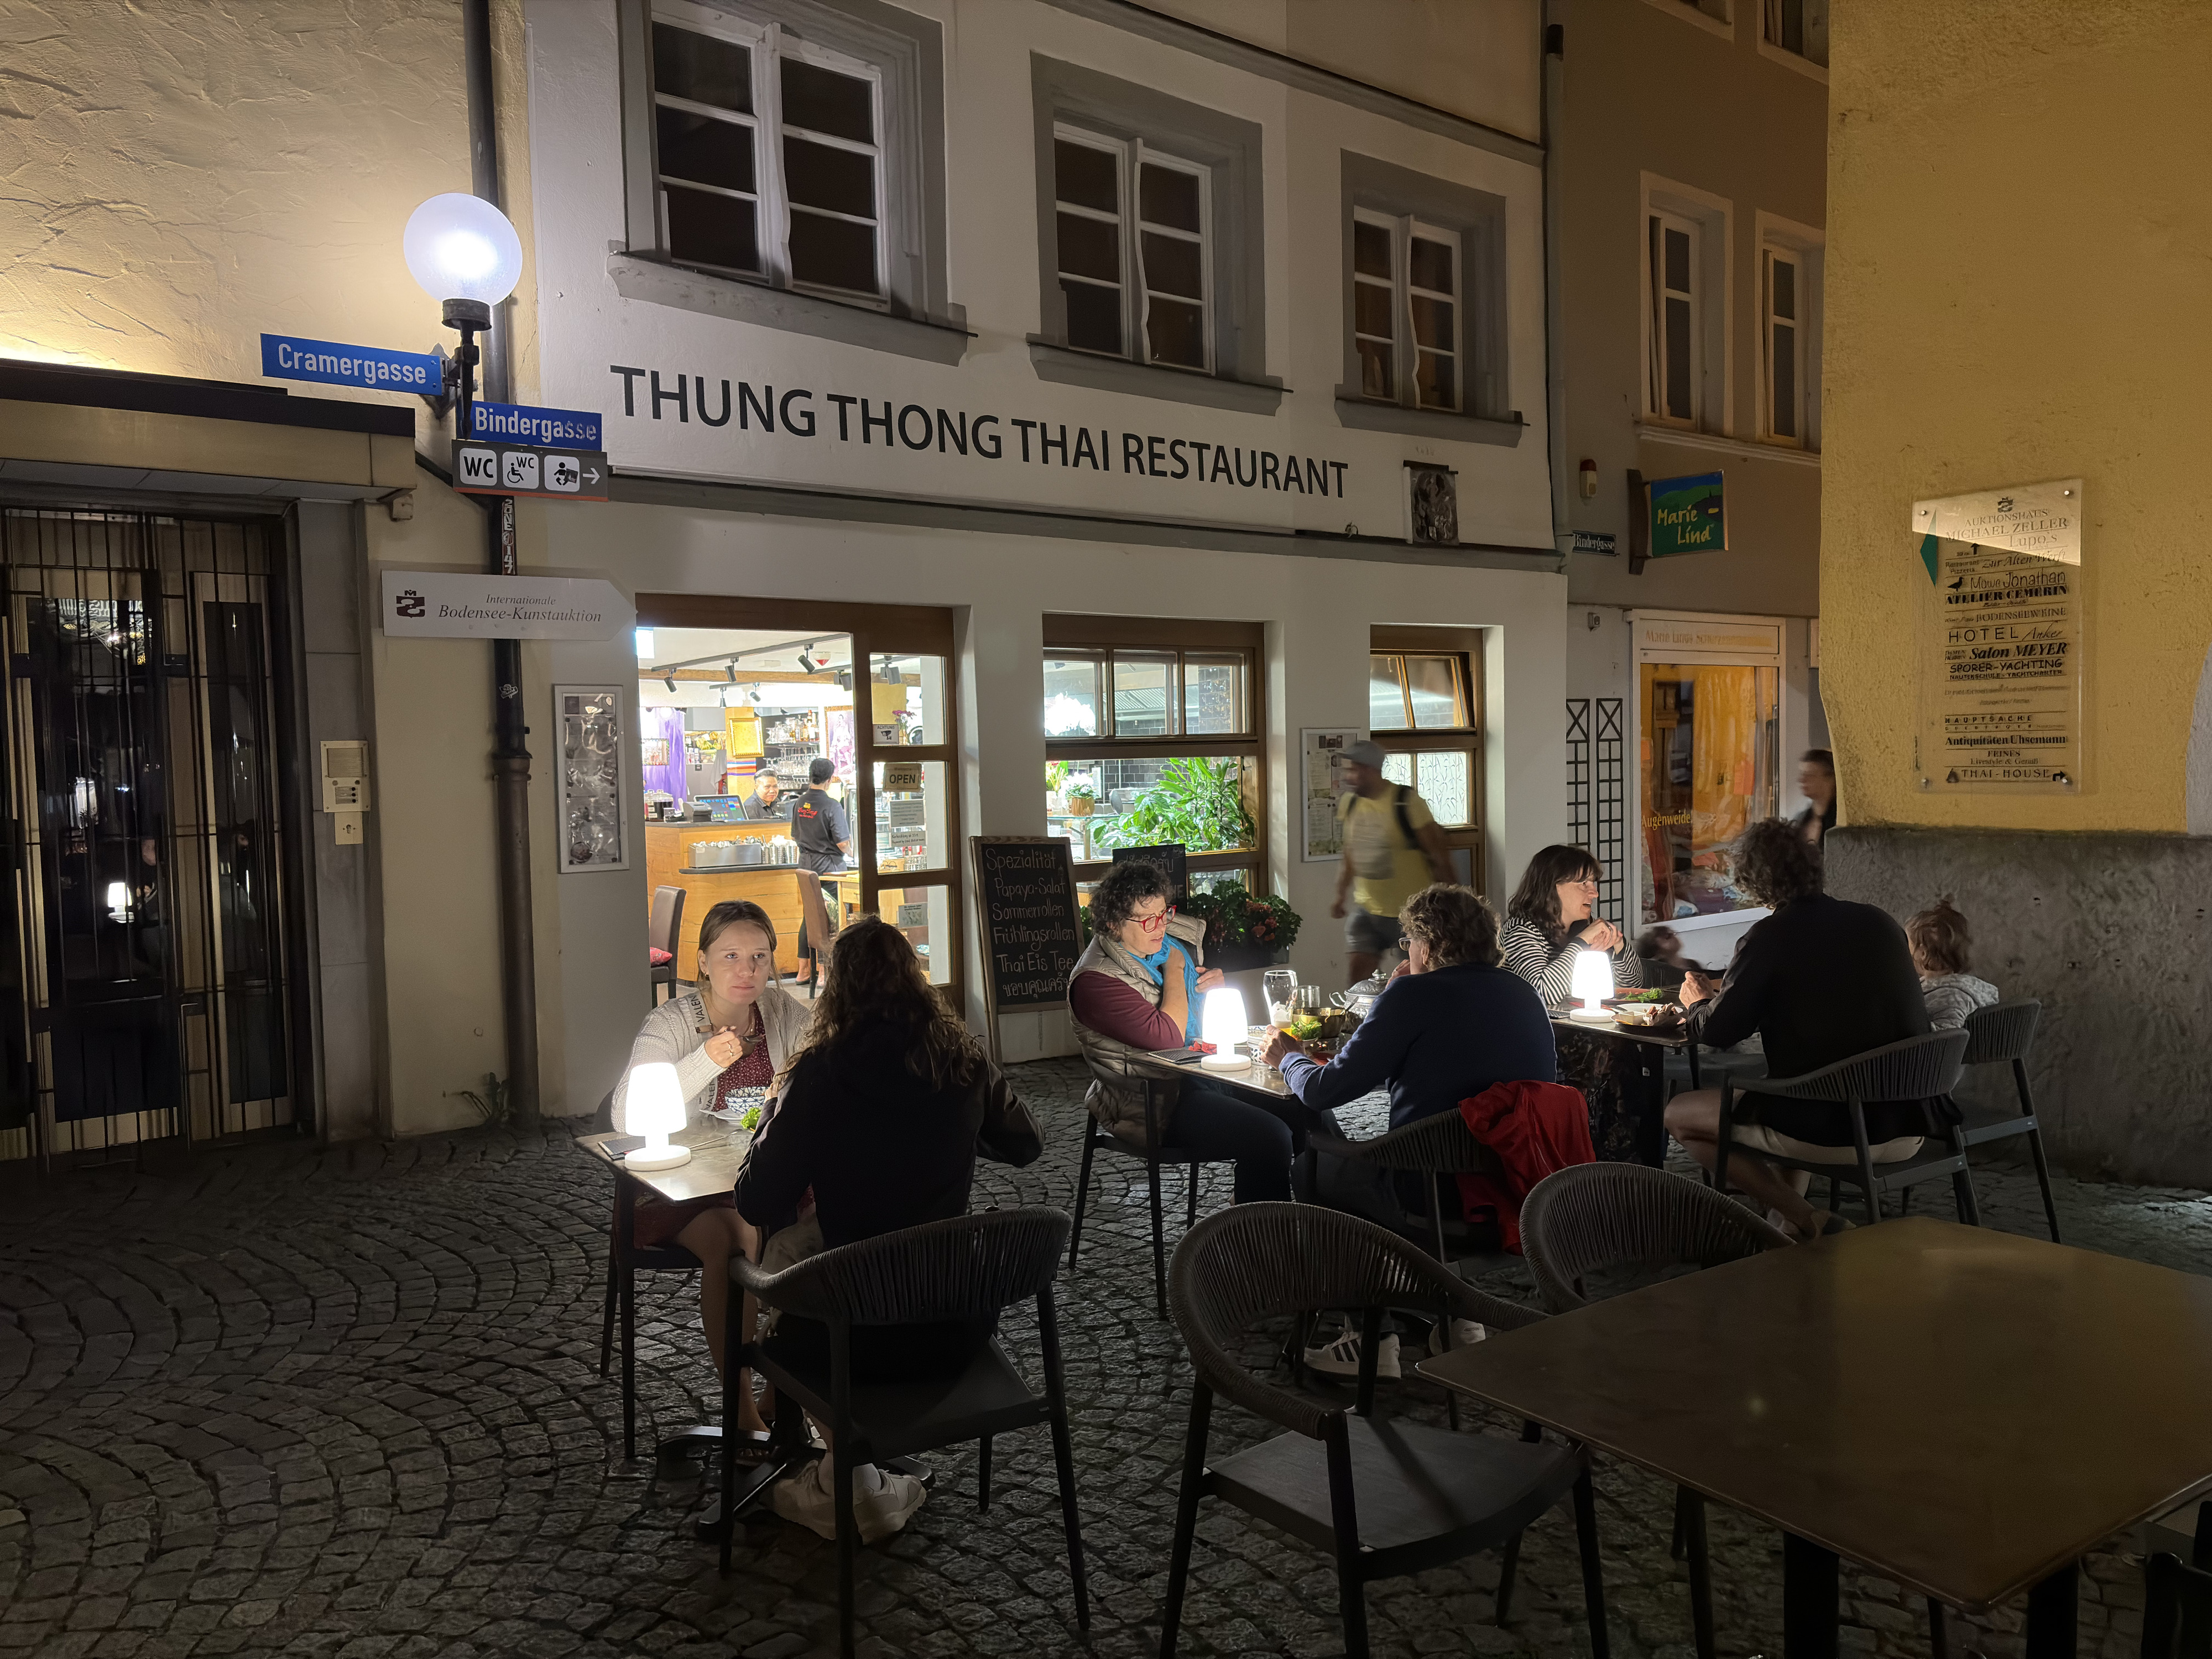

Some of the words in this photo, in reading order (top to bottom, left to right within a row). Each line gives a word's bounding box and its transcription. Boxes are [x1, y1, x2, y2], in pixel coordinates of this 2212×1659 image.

[278, 343, 426, 385] Cramergasse
[475, 406, 597, 443] Bindergasse
[610, 364, 816, 437] THUNG
[827, 393, 1002, 459] THONG
[1011, 418, 1109, 472] THAI
[1123, 432, 1349, 499] RESTAURANT
[463, 456, 494, 478] WC
[516, 456, 534, 469] WC
[1657, 504, 1698, 526] Marie
[1965, 509, 2049, 526] AUKTIONSHAUS
[1677, 524, 1712, 545] Lind
[1945, 524, 2010, 541] MICHAEL
[2012, 517, 2068, 534] ZELLER
[1573, 533, 1615, 551] Bindergasse
[2002, 567, 2065, 588] Jonathan
[486, 594, 556, 606] Internationale
[1945, 591, 2002, 605] ATELIER
[438, 604, 602, 622] Bodensee-Kunstauktion
[1976, 608, 2066, 623] BODENSEEWEINE
[1949, 627, 2018, 643] HOTEL
[2022, 621, 2063, 641] Anker
[1969, 646, 2010, 660] Salon
[2013, 642, 2067, 657] MEYER
[889, 774, 916, 784] OPEN
[985, 848, 1056, 878] Spezialität
[994, 877, 1066, 902] Papaya-Salat
[992, 898, 1065, 921] Sommerrollen
[993, 921, 1075, 952] Frühlingsrollen
[996, 953, 1025, 973] Thai
[1027, 952, 1048, 971] Eis
[1049, 951, 1074, 971] Tee
